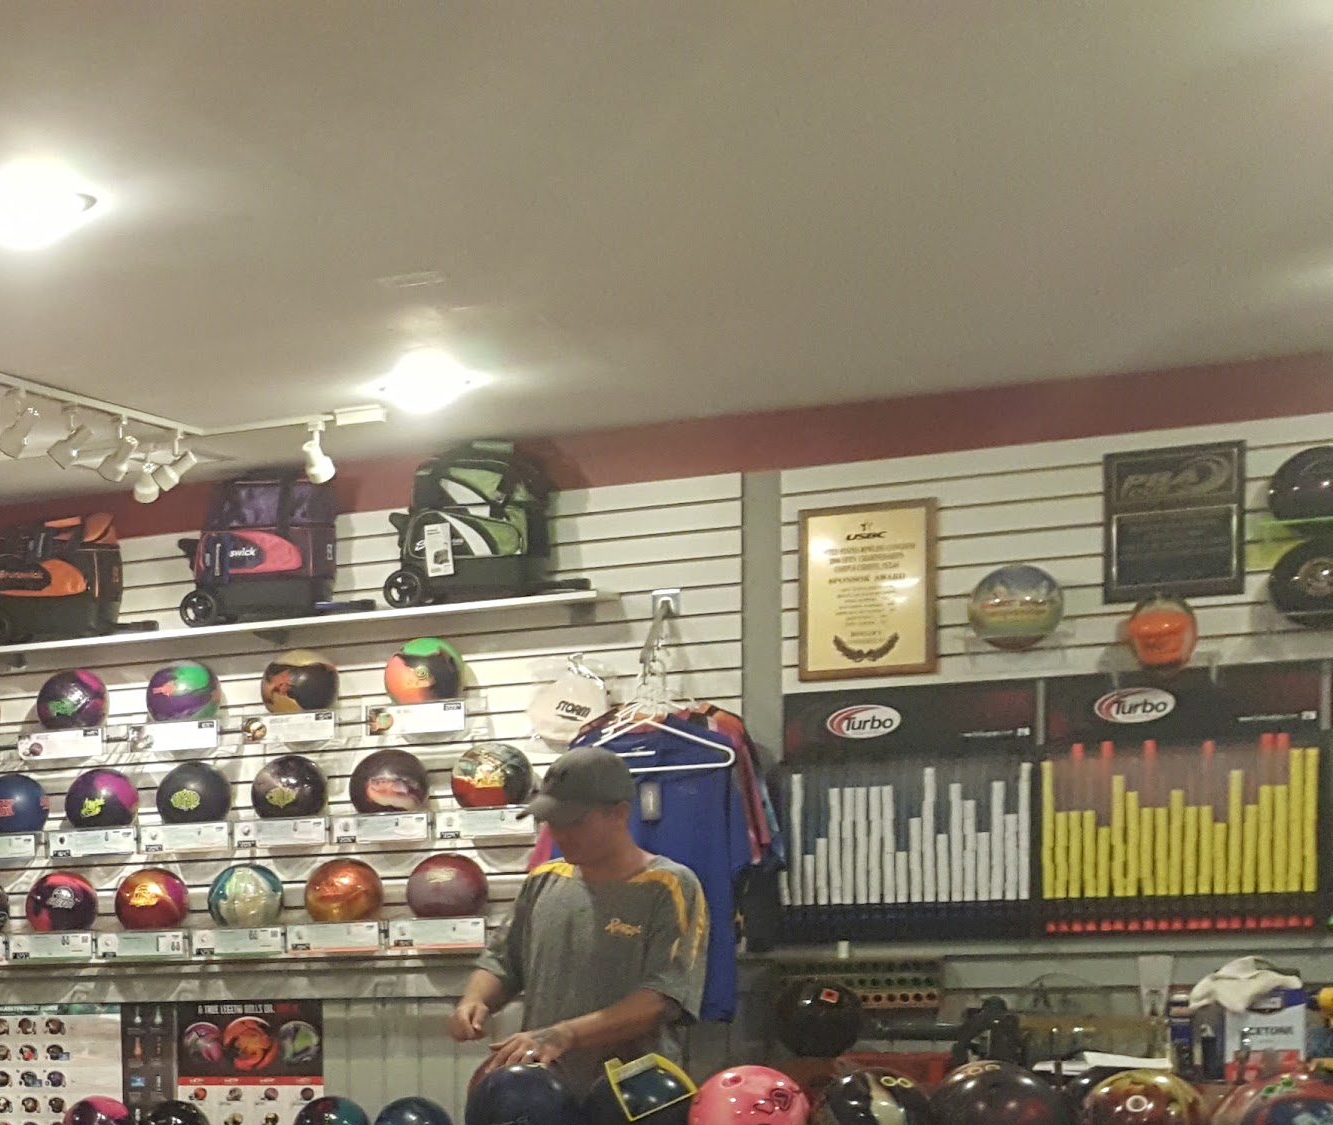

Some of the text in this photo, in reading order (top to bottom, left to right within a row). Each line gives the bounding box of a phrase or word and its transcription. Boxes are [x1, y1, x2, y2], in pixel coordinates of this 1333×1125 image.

[228, 546, 257, 559] swick
[556, 699, 592, 718] STORM
[1111, 698, 1170, 716] Turbo
[842, 715, 894, 733] Turbo
